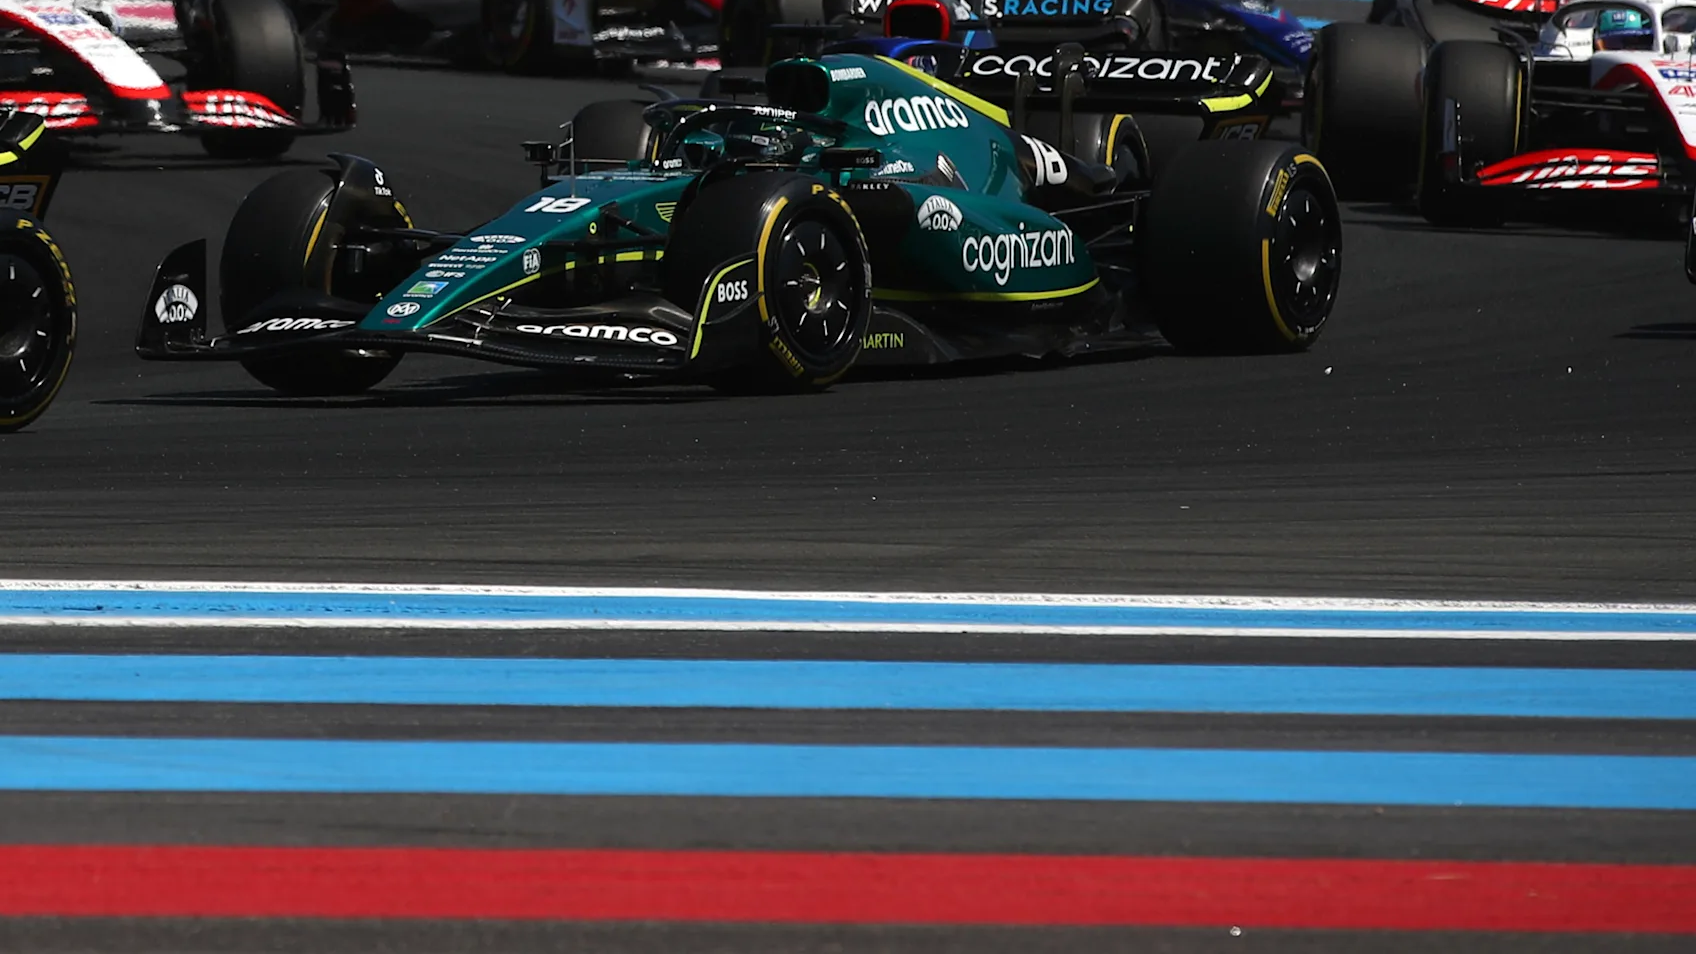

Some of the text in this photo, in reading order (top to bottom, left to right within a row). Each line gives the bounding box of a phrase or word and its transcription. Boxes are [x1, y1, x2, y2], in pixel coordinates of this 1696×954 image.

[830, 67, 867, 82] BOMBARDIER
[864, 95, 969, 136] aramco
[1021, 134, 1068, 186] 18
[373, 185, 393, 196] TikTok
[524, 196, 592, 213] 18
[926, 196, 954, 213] ITALIA
[439, 254, 497, 263] NetApp
[962, 222, 1075, 286] cognizant
[717, 279, 749, 303] BOSS
[236, 317, 357, 334] aramco
[516, 323, 679, 346] aramco
